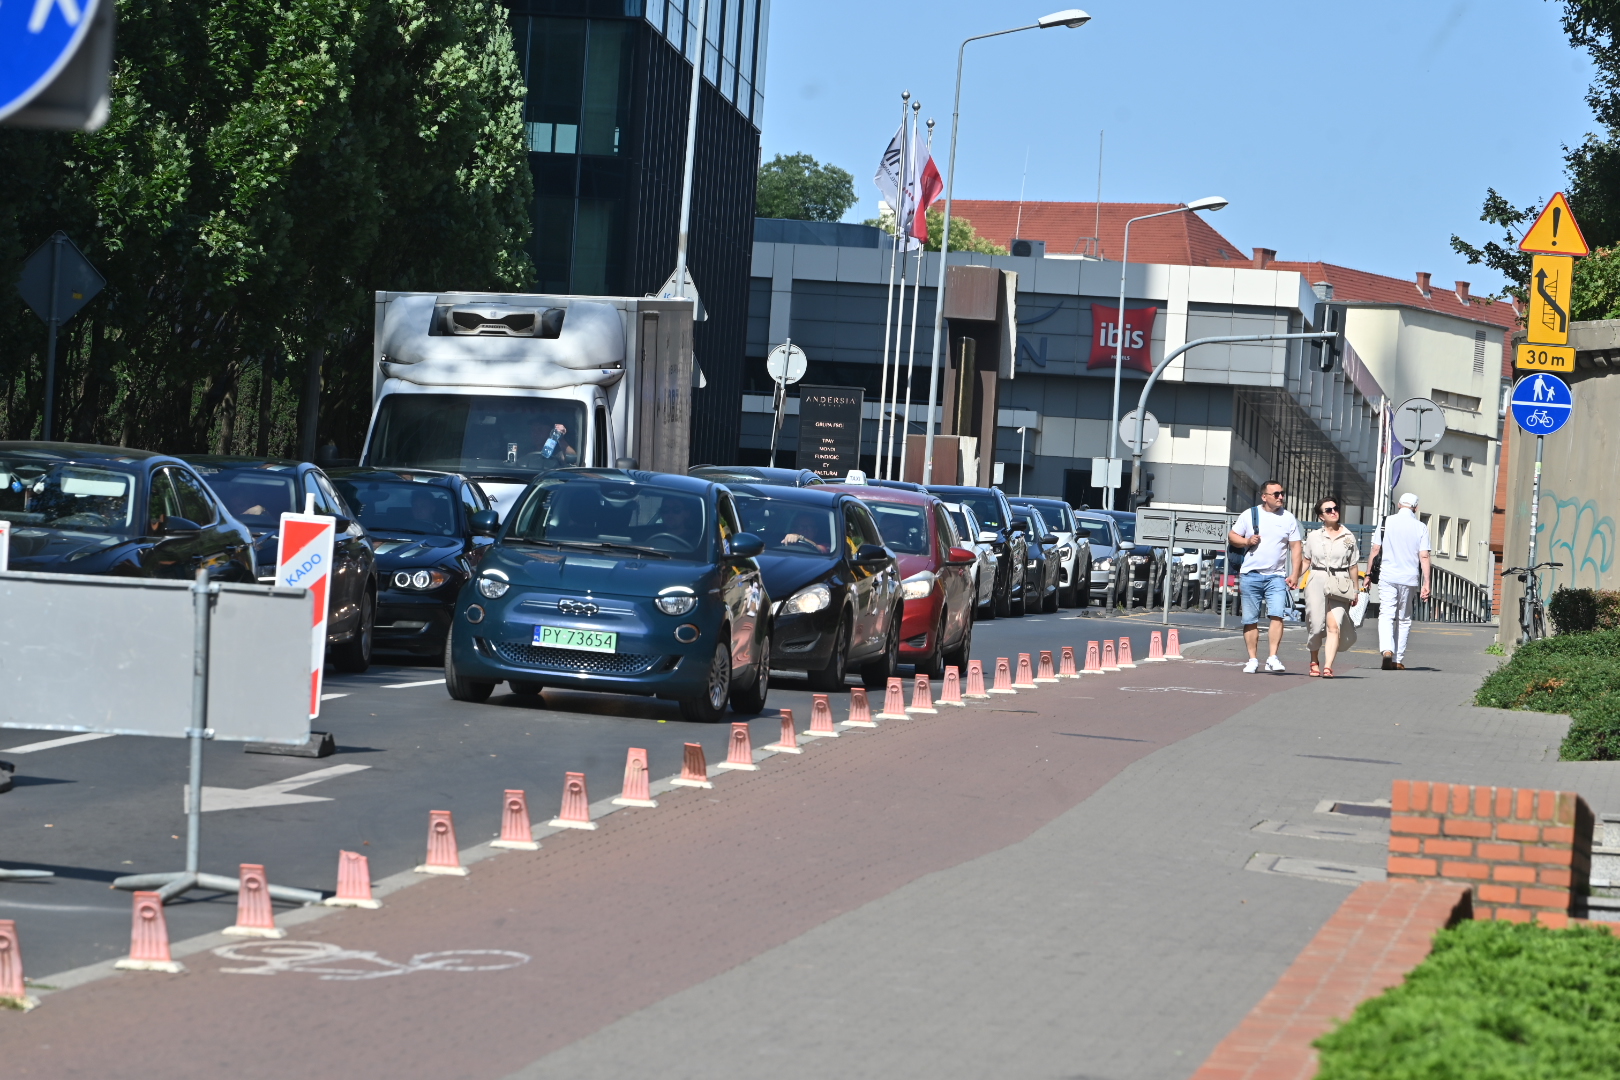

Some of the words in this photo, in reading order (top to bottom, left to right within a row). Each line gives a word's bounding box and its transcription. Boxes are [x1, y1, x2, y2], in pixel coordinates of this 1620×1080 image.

[1100, 321, 1144, 349] ibis
[1526, 349, 1548, 365] 30
[1551, 355, 1565, 366] m
[806, 396, 855, 404] ANDERSIA
[285, 553, 322, 587] KADO
[542, 628, 562, 643] PY
[567, 631, 613, 649] 73654
